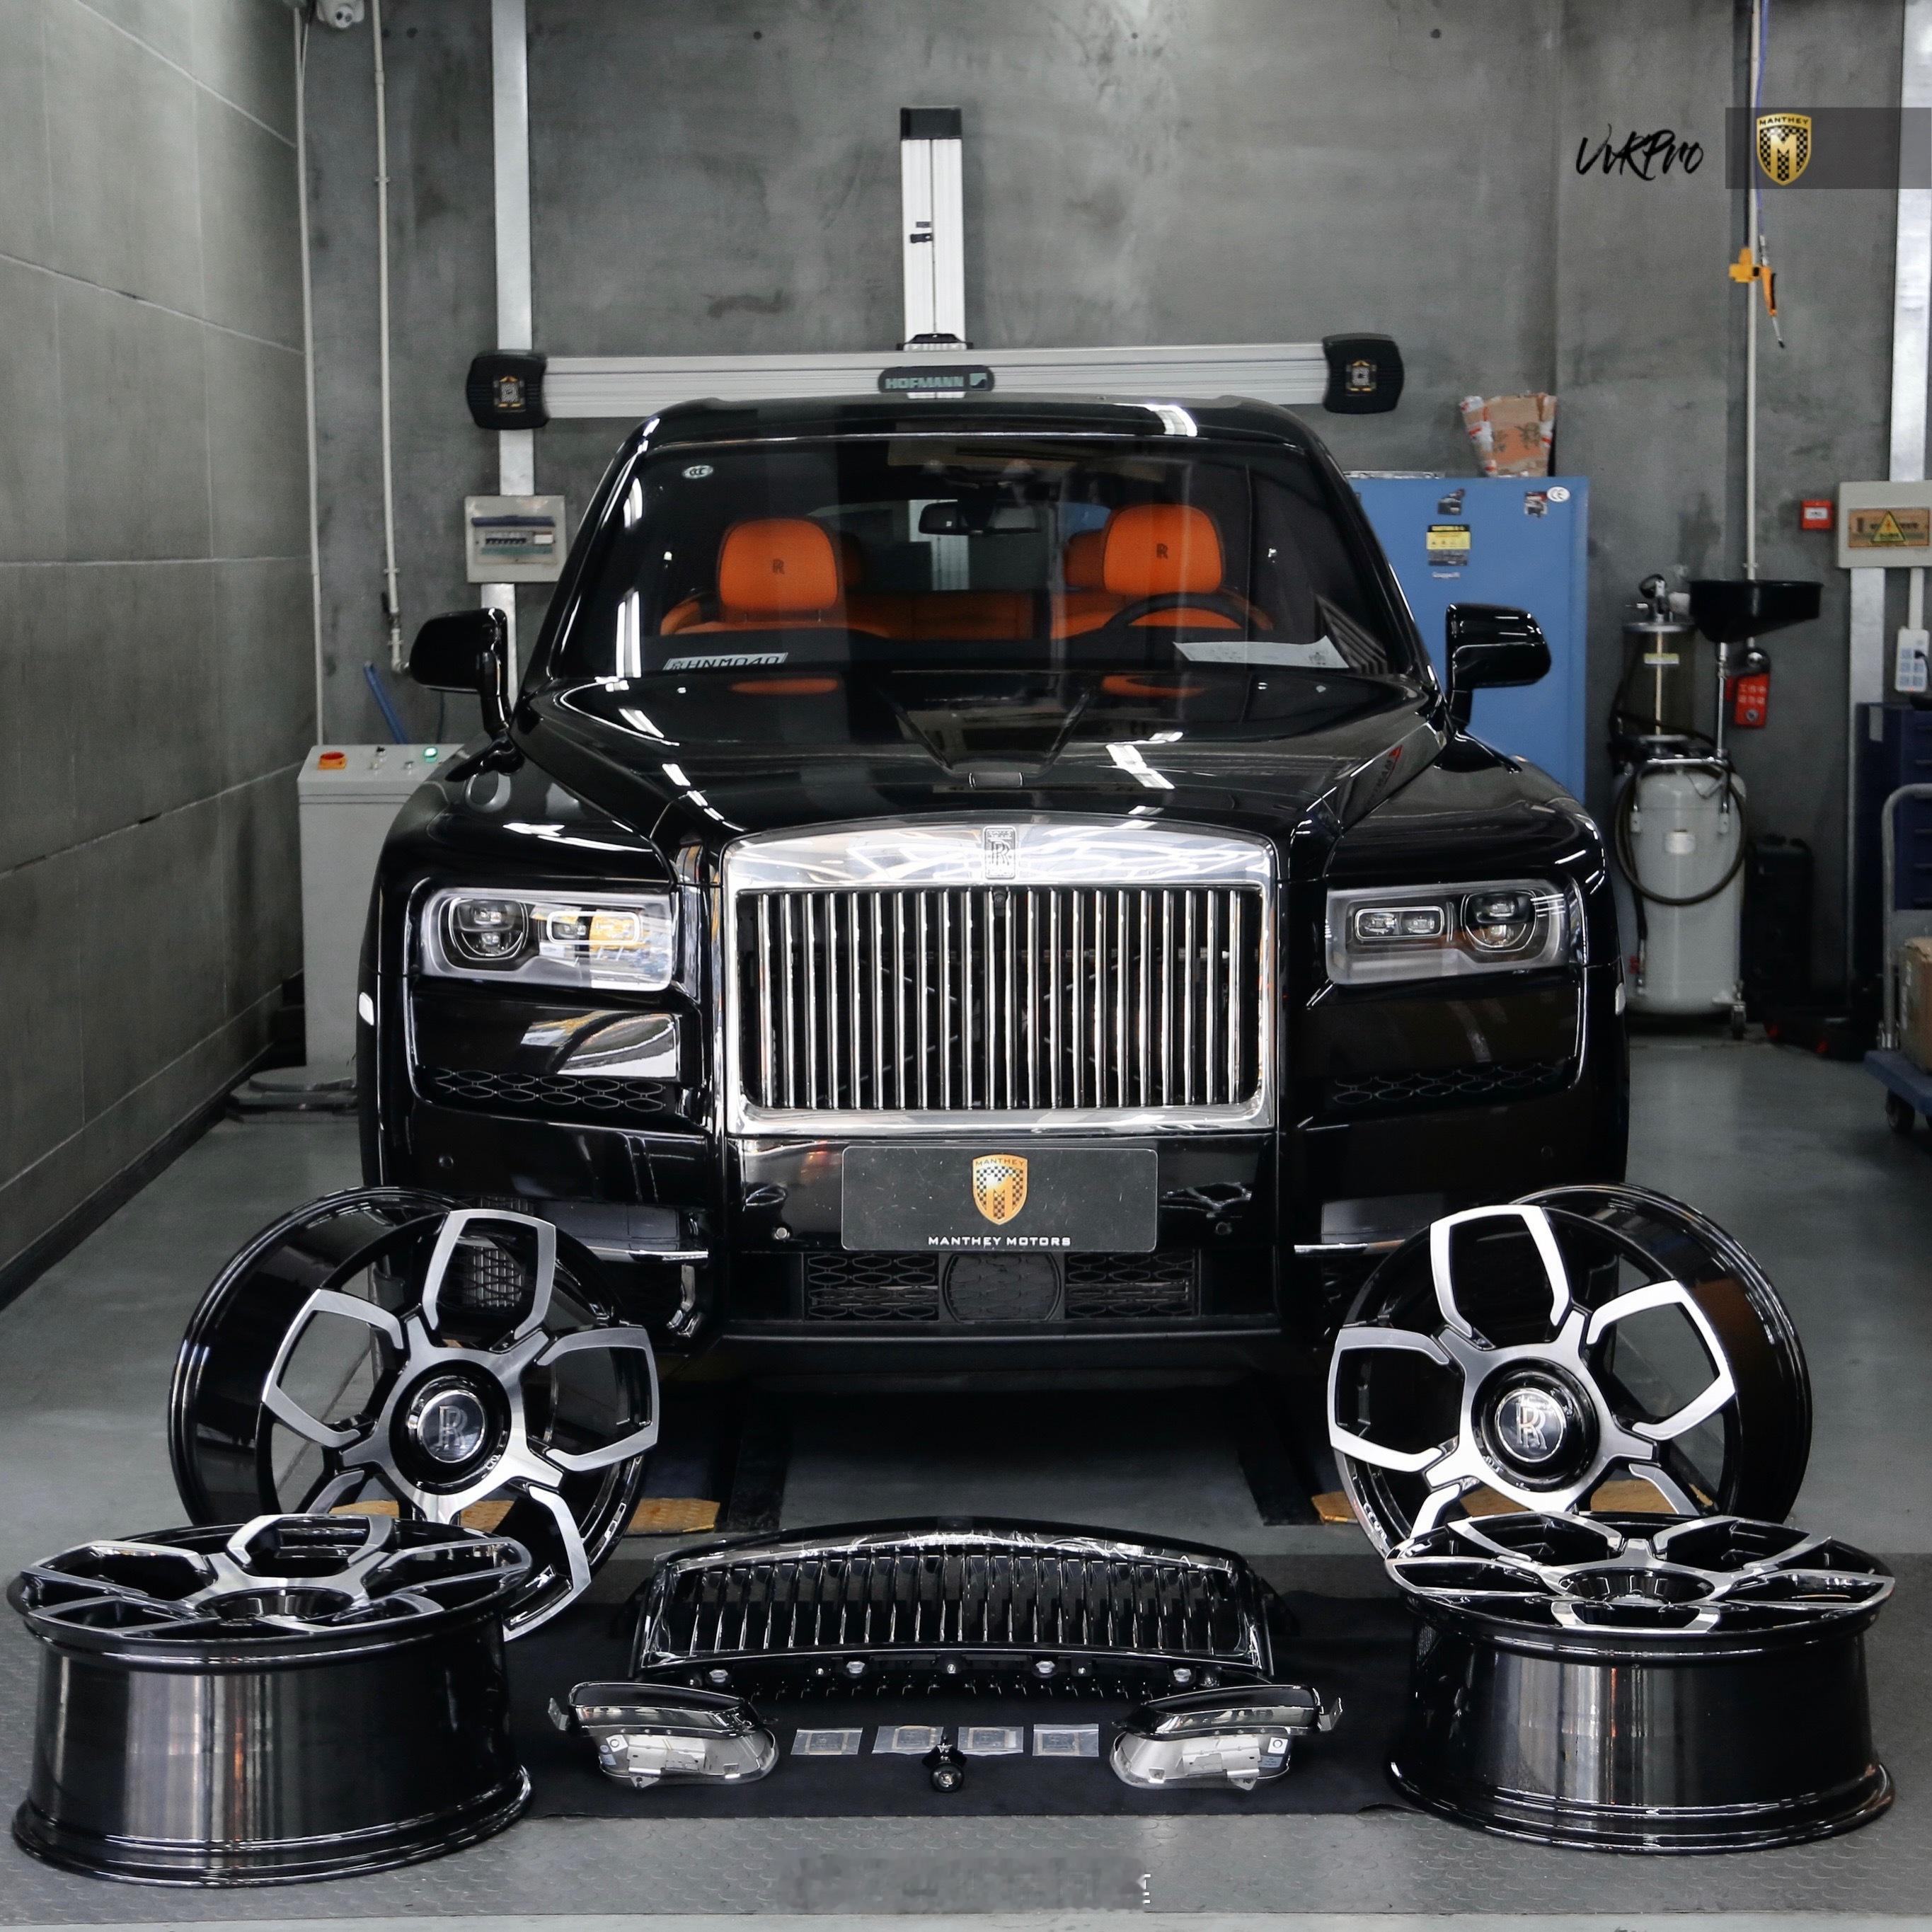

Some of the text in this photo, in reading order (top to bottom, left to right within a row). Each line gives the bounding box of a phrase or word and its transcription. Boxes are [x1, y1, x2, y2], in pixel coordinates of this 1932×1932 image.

[885, 376, 964, 389] HOFMANN
[975, 1158, 1025, 1166] MANTHEY
[928, 1236, 1071, 1246] MANTHEY MOTORS
